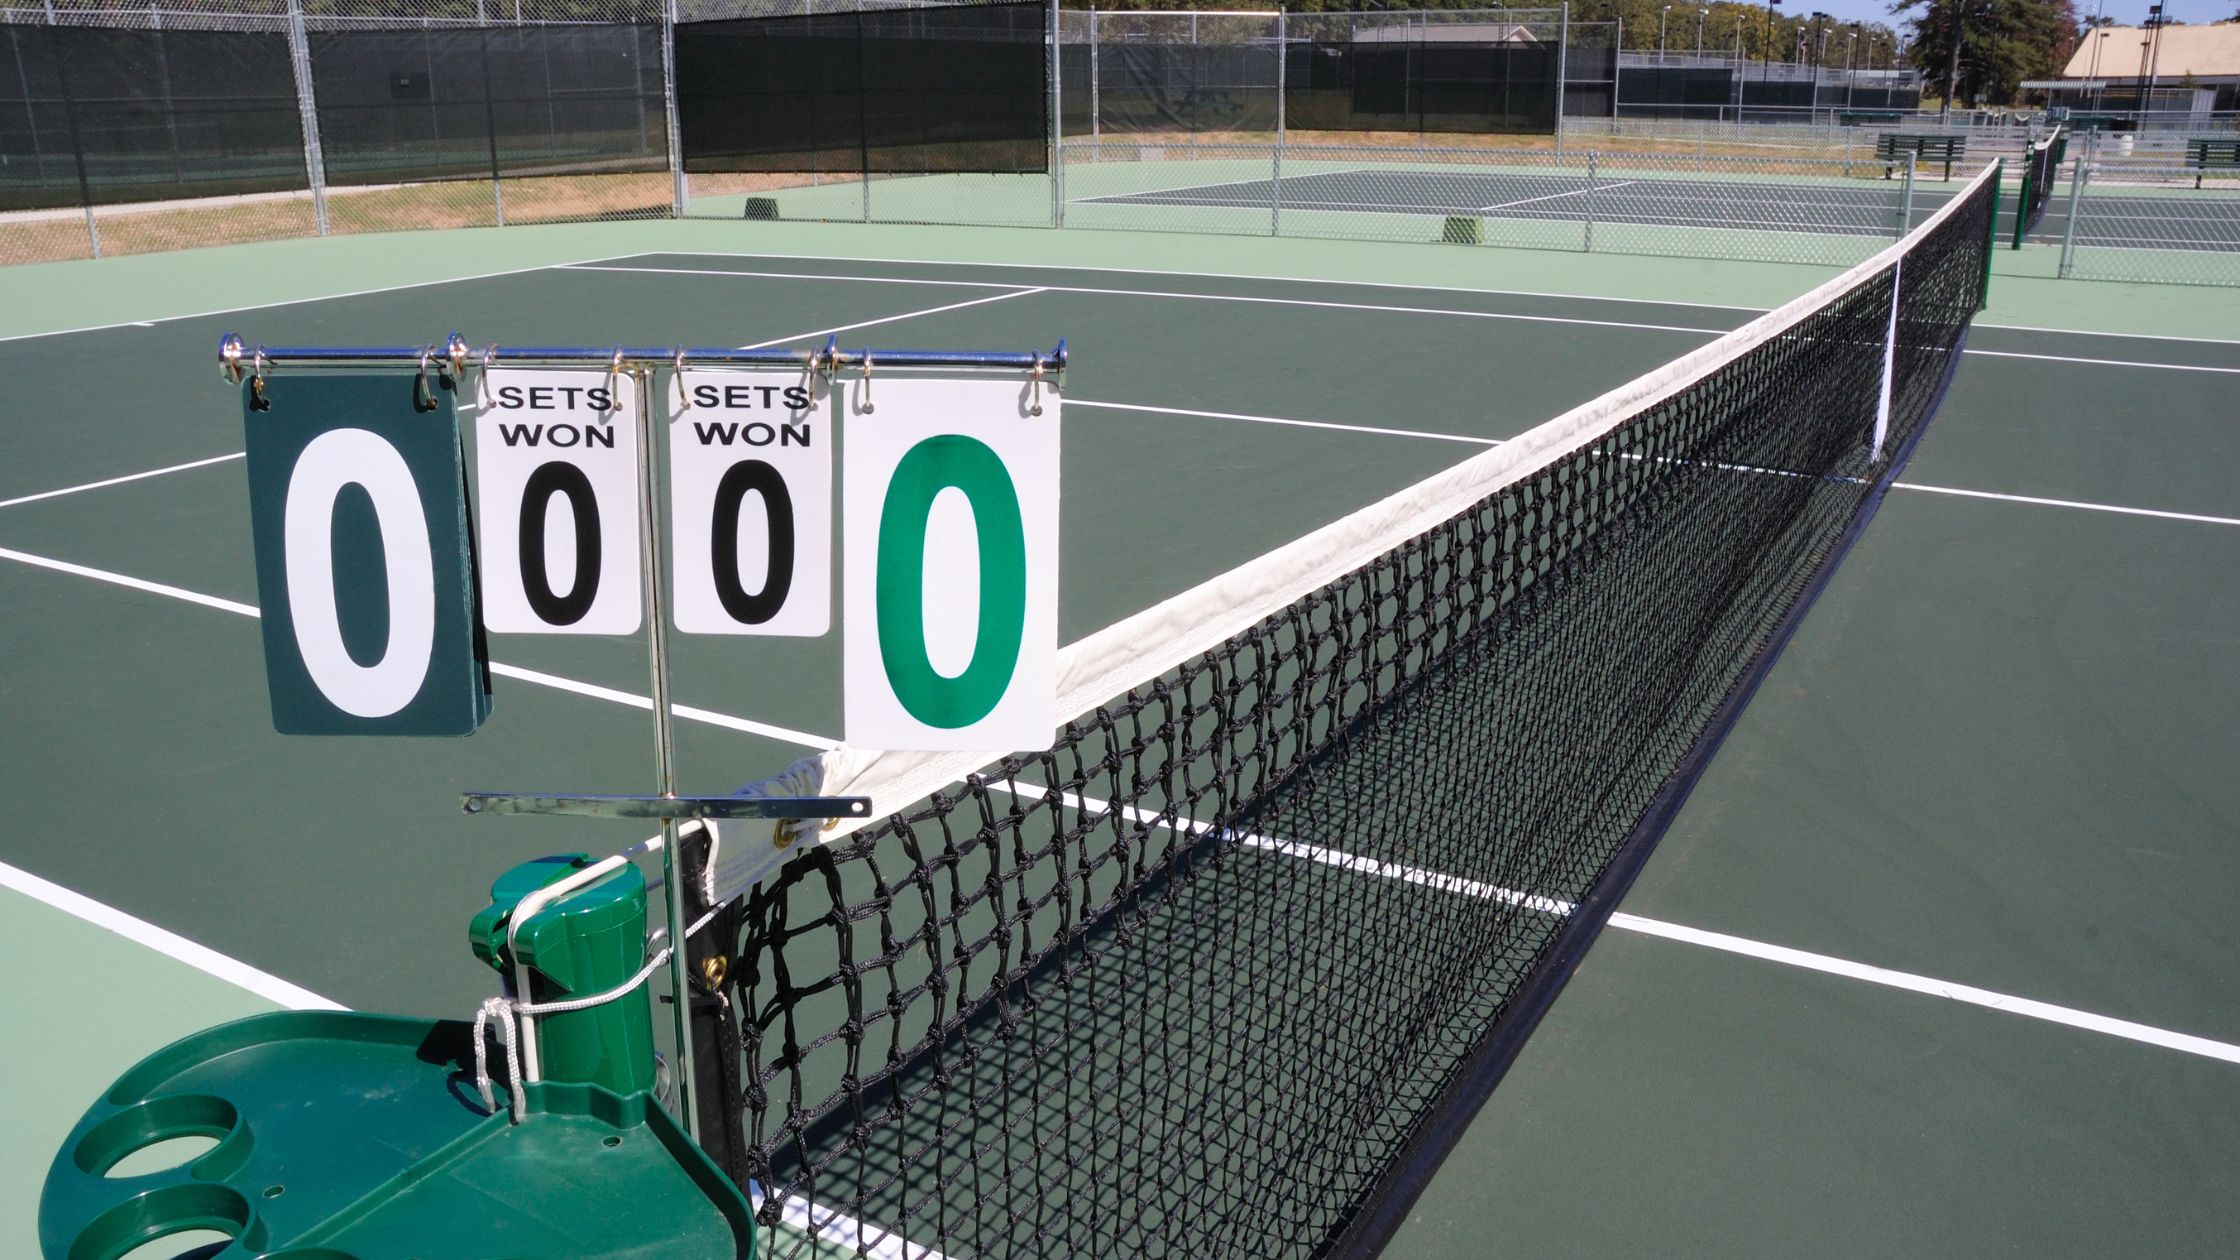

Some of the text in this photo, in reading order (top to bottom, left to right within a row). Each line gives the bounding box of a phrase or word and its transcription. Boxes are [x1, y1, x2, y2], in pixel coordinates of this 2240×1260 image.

[498, 386, 612, 411] SETS
[498, 423, 615, 448] WON
[693, 385, 810, 410] SETS
[693, 422, 811, 447] WON
[284, 427, 435, 718] 0
[518, 460, 602, 627] 0
[711, 459, 795, 625] 0
[876, 434, 1027, 729] 0
